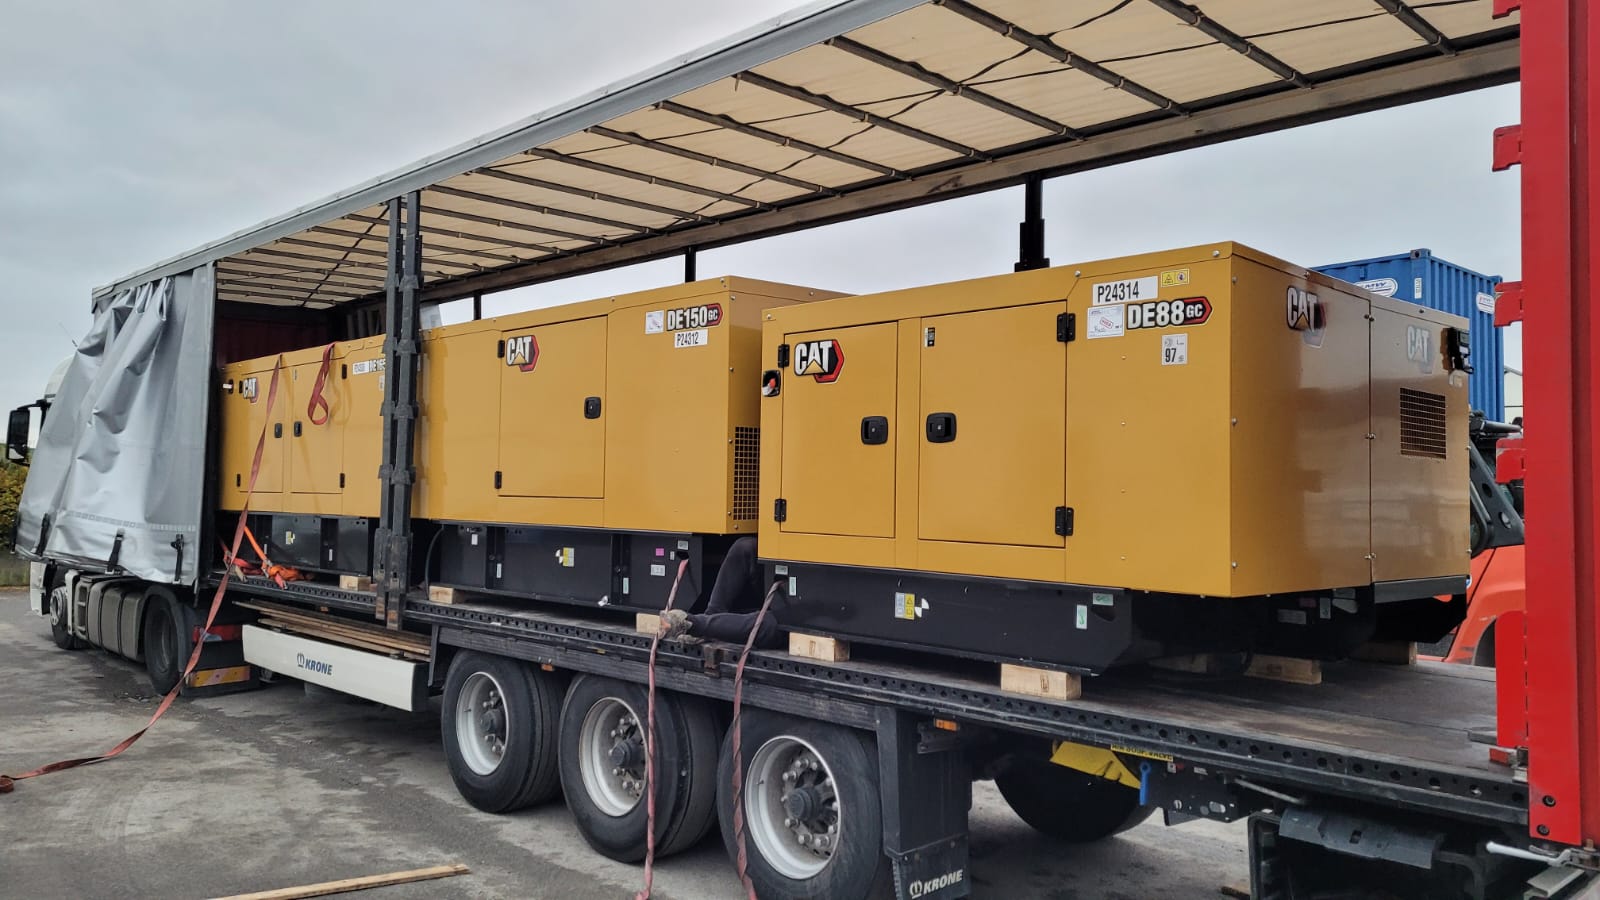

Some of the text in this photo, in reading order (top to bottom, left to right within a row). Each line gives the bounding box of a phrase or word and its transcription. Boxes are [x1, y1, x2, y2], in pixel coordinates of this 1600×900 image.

[1097, 280, 1140, 303] P24314
[667, 305, 708, 331] DE150
[1127, 301, 1185, 329] DE88
[1186, 303, 1203, 318] GC
[1287, 286, 1318, 333] CAT
[506, 335, 532, 365] CAT
[676, 331, 699, 347] P24312
[1406, 324, 1431, 363] CAT
[794, 339, 833, 376] CAT
[1165, 347, 1177, 363] 97
[243, 377, 257, 399] CAT
[305, 658, 333, 676] KRONE
[923, 868, 964, 895] KRONE
